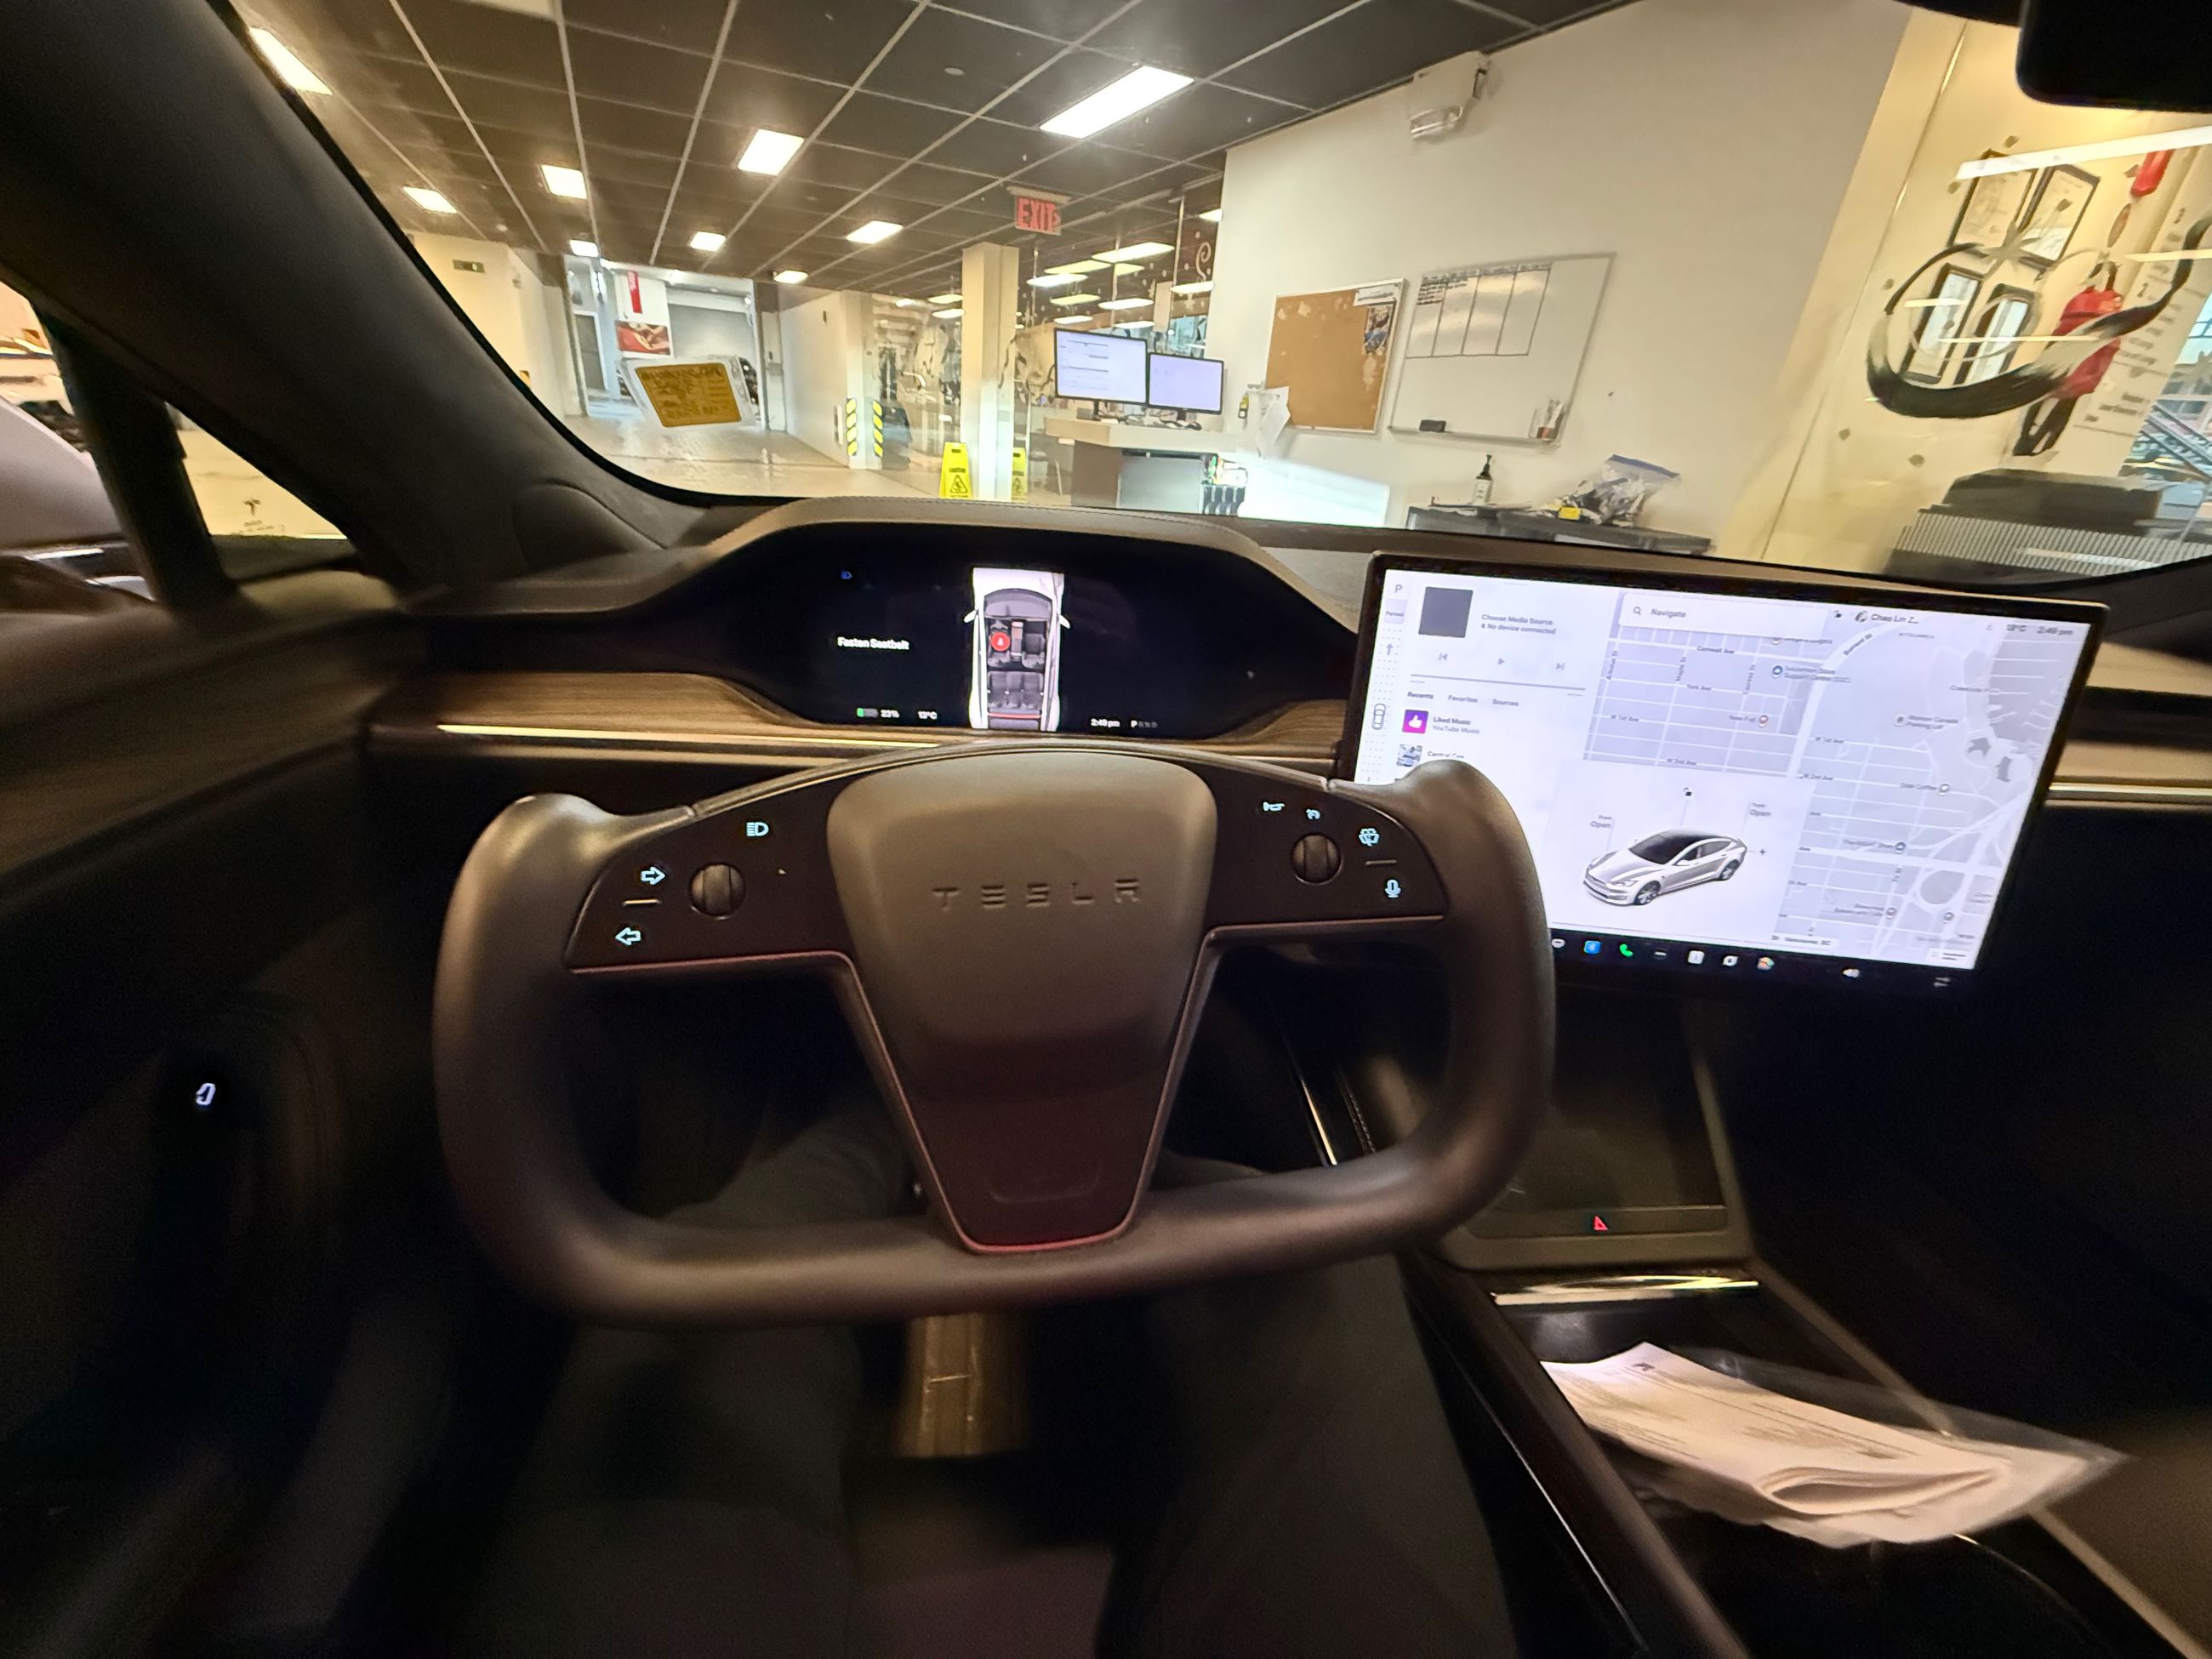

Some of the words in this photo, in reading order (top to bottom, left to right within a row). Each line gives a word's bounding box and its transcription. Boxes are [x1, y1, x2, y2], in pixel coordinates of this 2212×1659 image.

[1018, 197, 1055, 231] EXIT
[1394, 584, 1402, 593] P
[1651, 608, 1686, 619] Navigate
[1521, 625, 1557, 634] connected
[837, 636, 869, 648] Fasten
[869, 638, 909, 650] Seatbelt
[1407, 691, 1434, 699] Recents
[1749, 809, 1771, 818] Open
[932, 878, 1139, 912] TESLA
